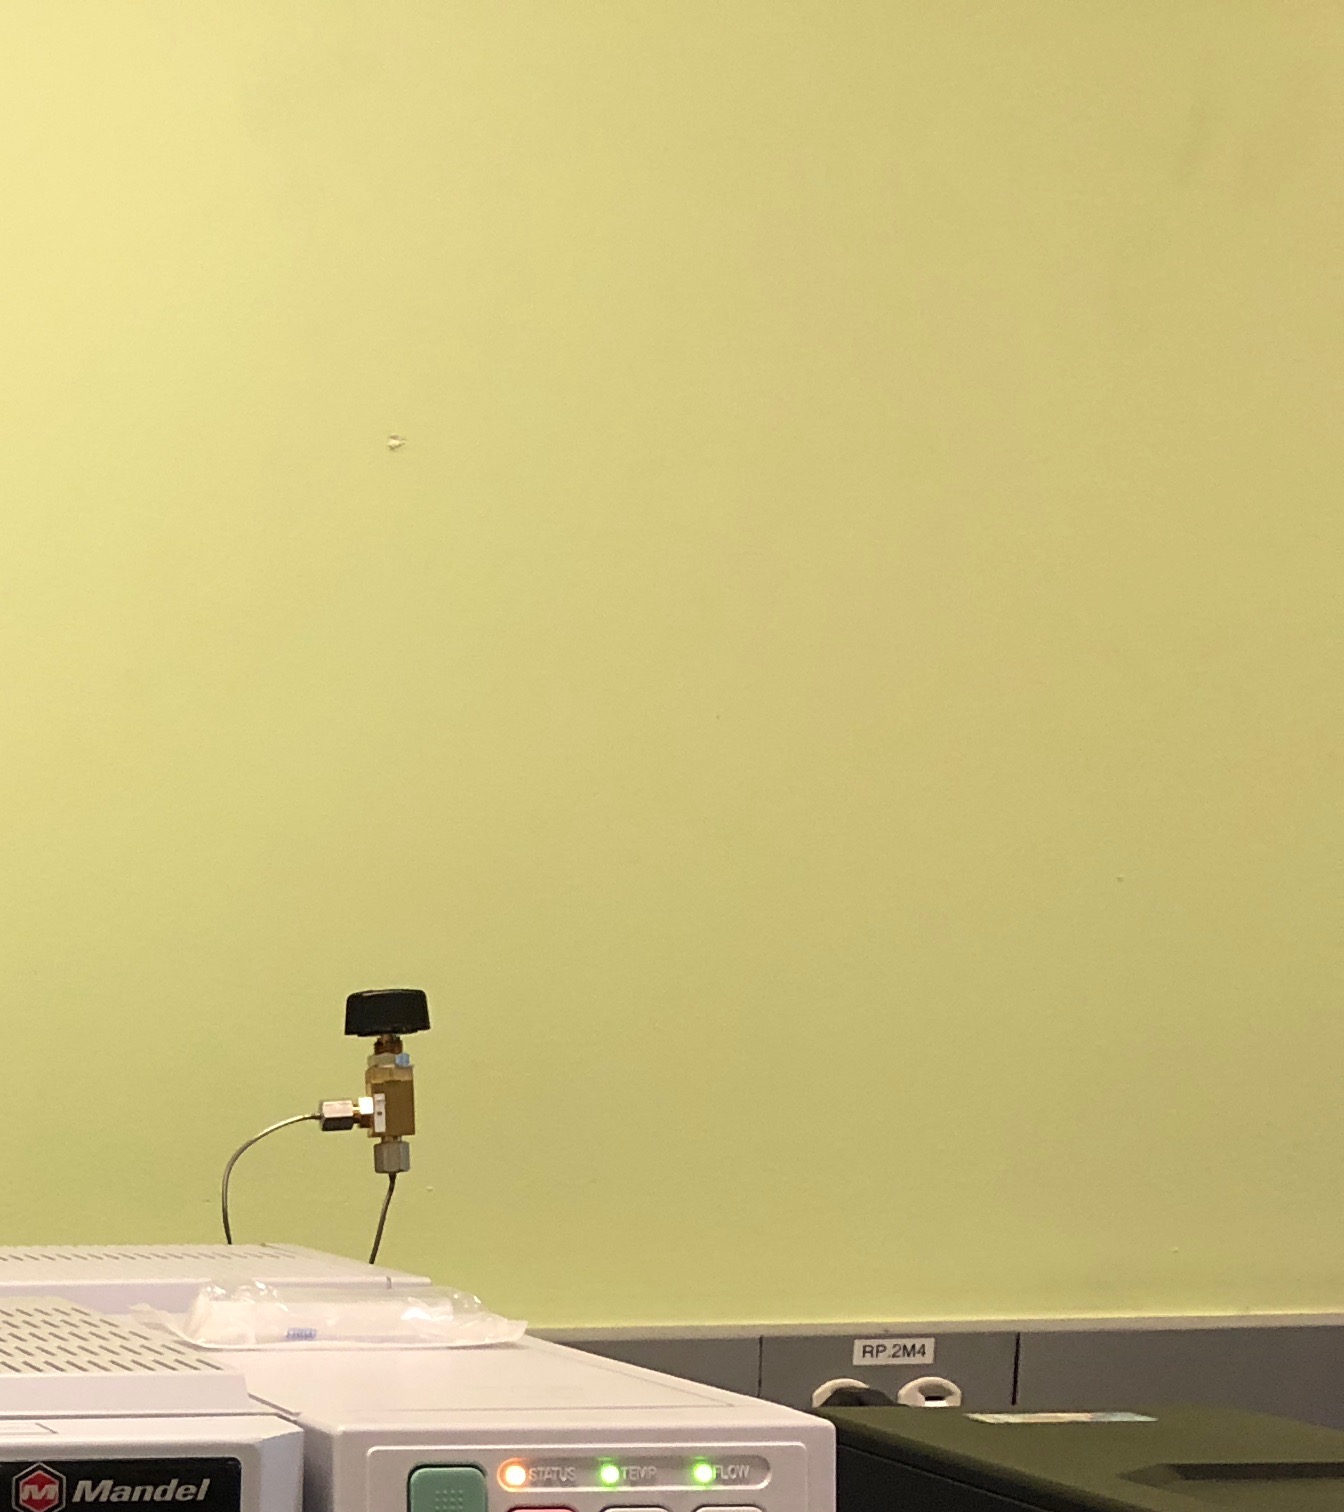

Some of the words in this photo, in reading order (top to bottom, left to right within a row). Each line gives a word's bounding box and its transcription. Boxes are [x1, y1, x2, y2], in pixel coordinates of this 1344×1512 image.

[528, 1466, 577, 1482] STATUS
[621, 1466, 657, 1480] TEMP
[714, 1465, 750, 1480] FLOW
[71, 1478, 210, 1503] Mandel
